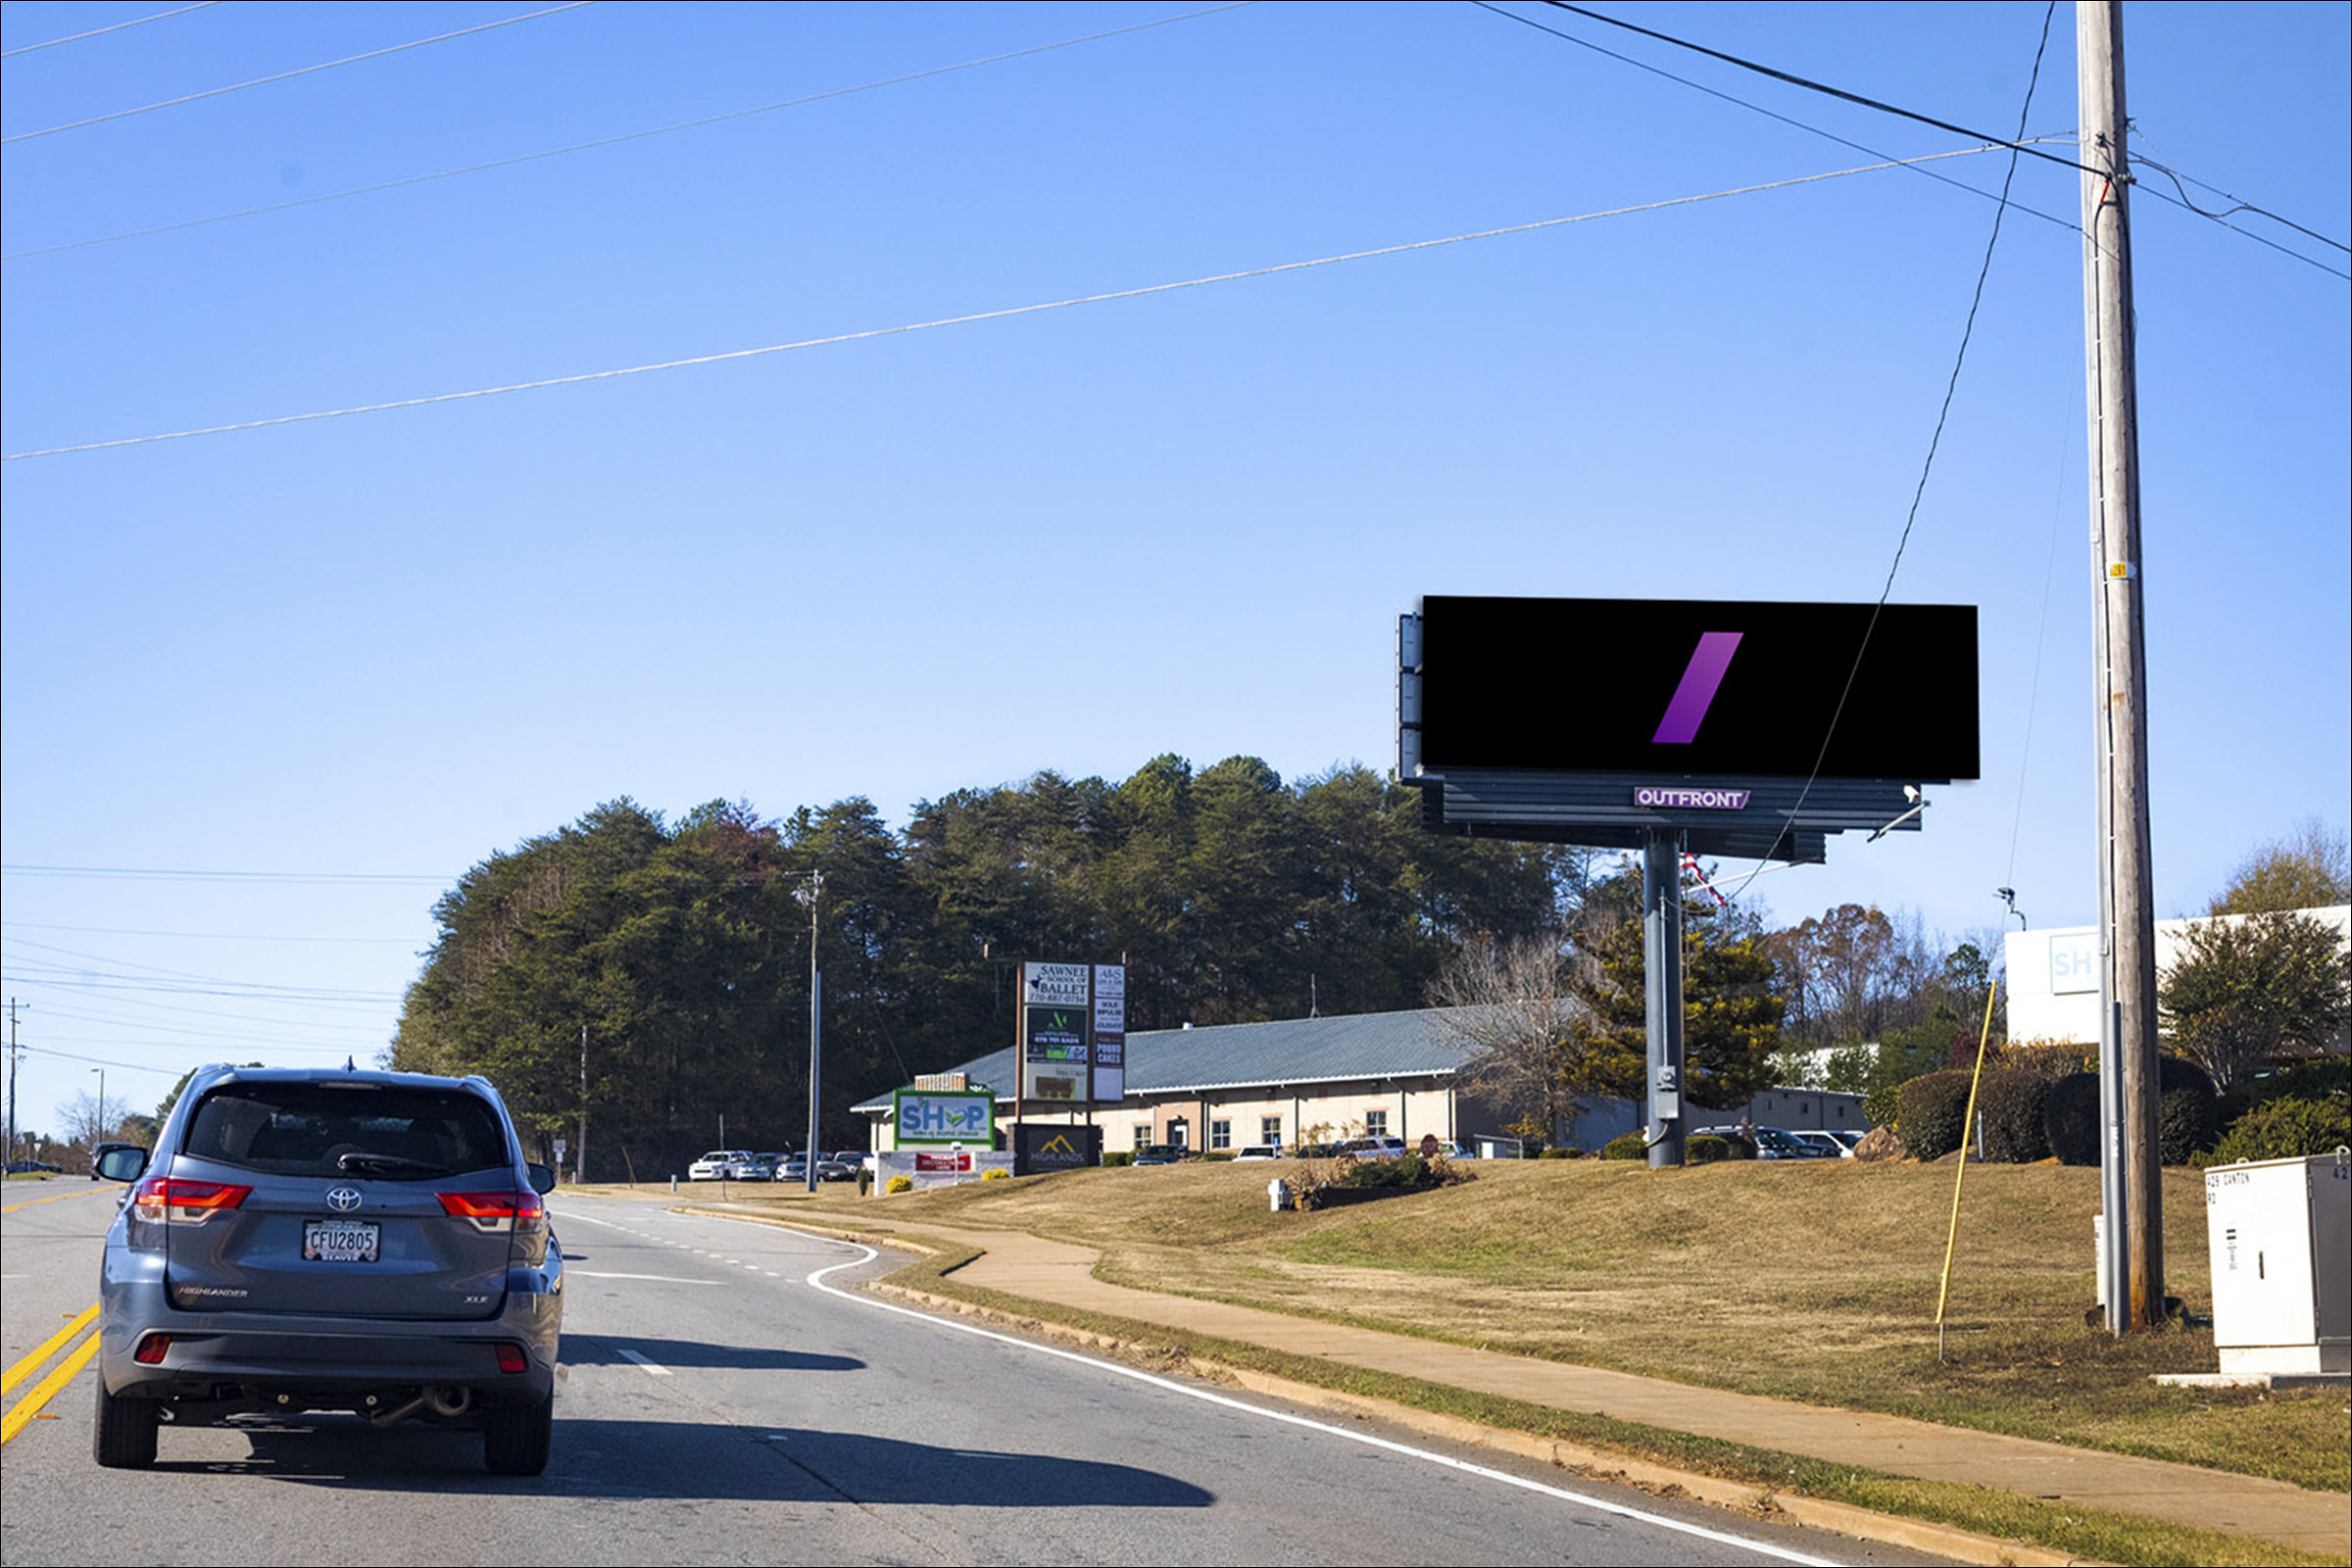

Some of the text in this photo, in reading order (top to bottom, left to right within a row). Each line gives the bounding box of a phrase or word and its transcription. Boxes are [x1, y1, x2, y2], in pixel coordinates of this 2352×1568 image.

[1639, 790, 1742, 807] OUTFRONT
[1041, 965, 1087, 977] SAWNEE
[2054, 951, 2093, 977] SH
[1041, 983, 1087, 995] BALLET
[902, 1104, 985, 1131] SHOP
[311, 1231, 373, 1251] CFU2805
[178, 1287, 249, 1298] HIGHLANDER
